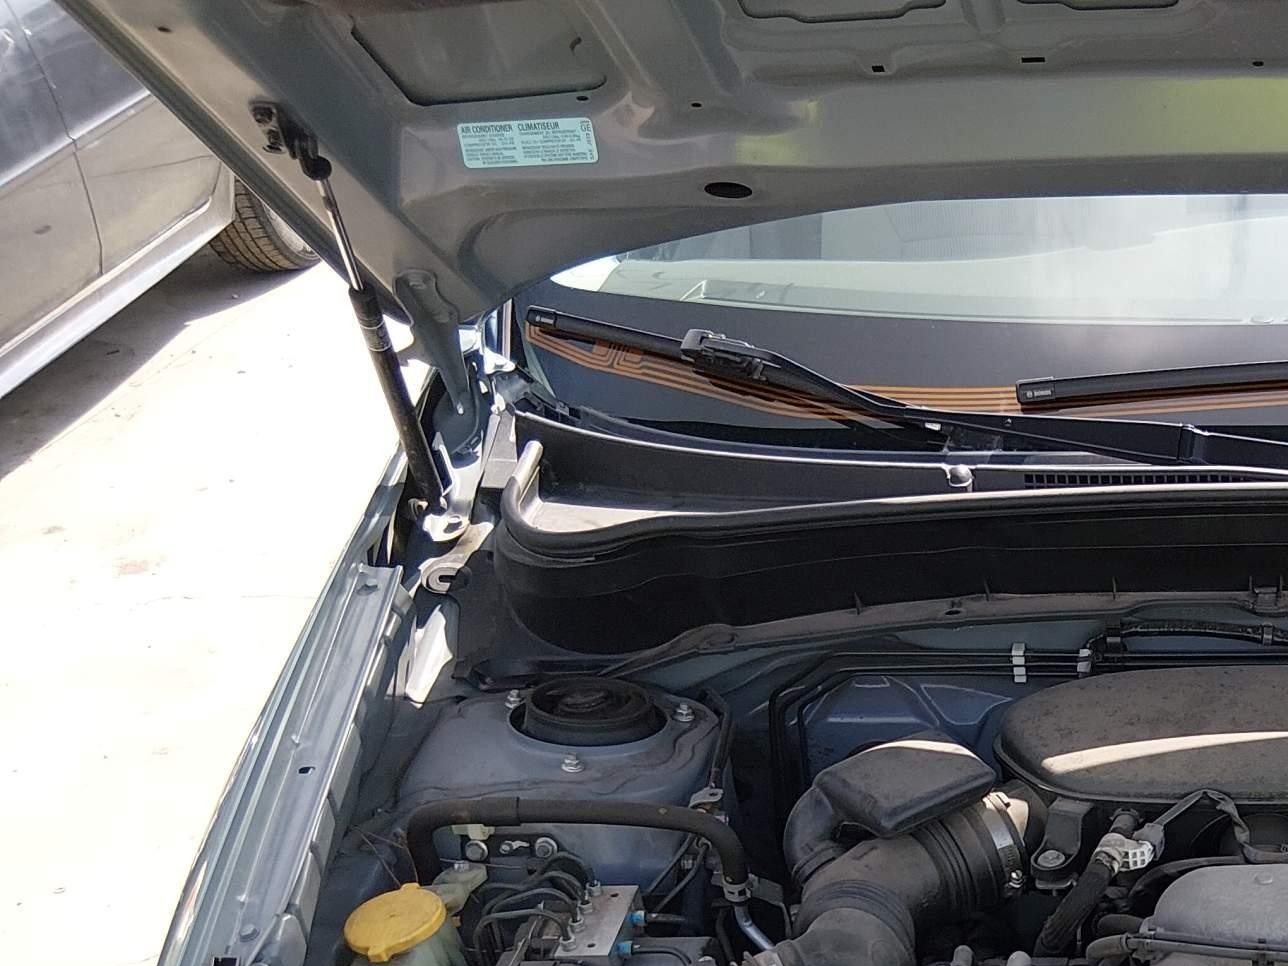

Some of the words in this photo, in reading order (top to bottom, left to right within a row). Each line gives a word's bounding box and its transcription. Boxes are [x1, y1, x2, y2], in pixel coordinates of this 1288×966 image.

[461, 125, 471, 134] AIR
[472, 123, 513, 134] CONDITIONER
[517, 121, 560, 132] CLIMATISEUR
